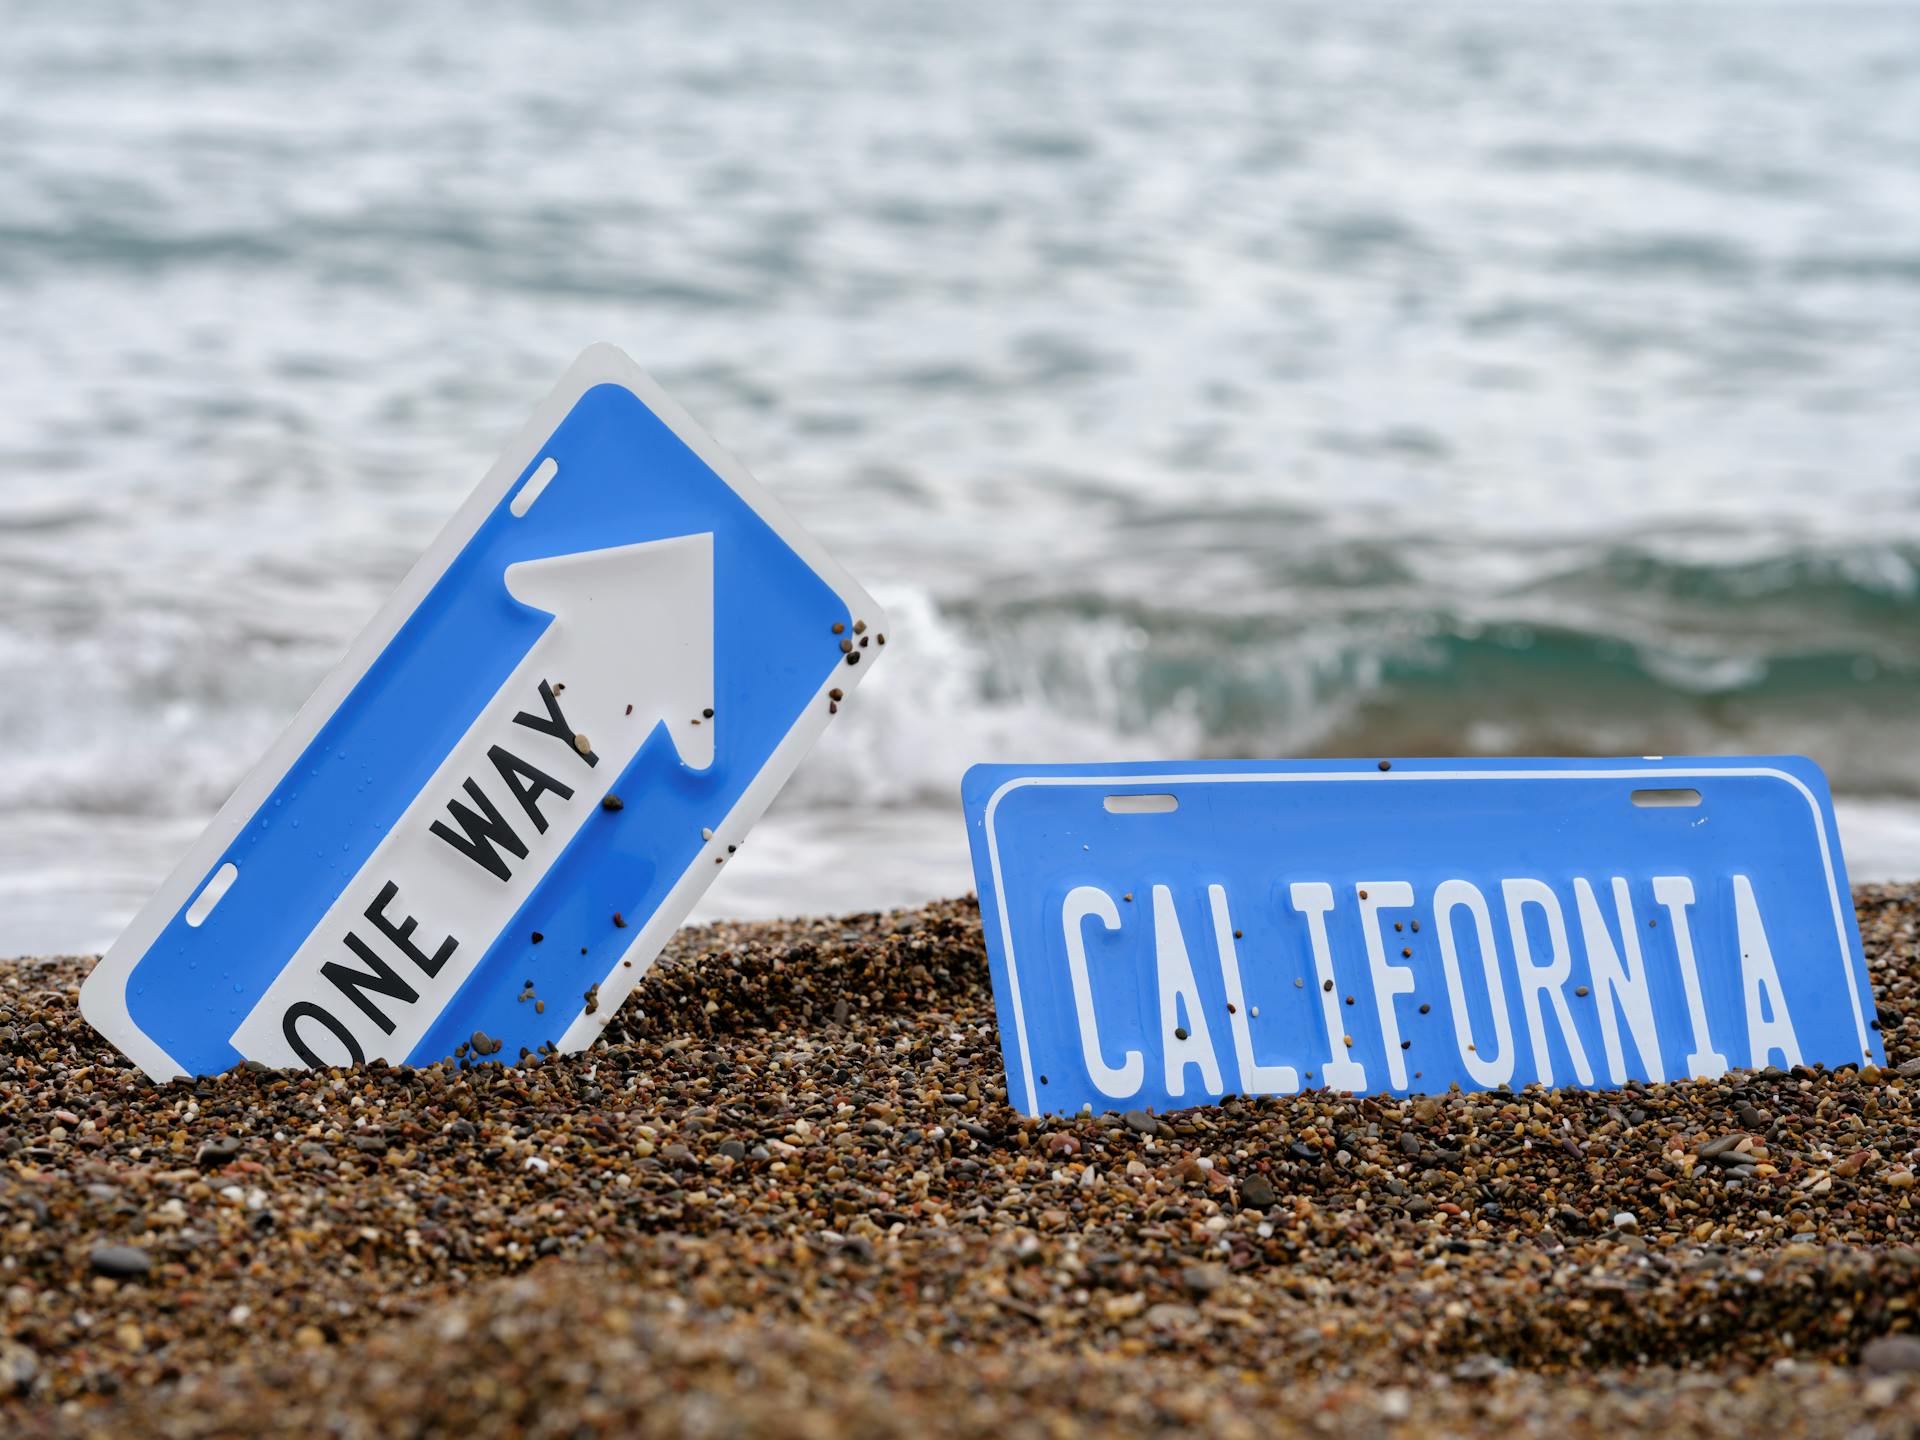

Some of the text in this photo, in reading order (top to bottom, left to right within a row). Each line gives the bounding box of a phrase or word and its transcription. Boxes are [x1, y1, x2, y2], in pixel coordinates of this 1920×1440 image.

[282, 678, 600, 1069] ONE WAY
[1061, 874, 1805, 1099] CALIFORNIA
